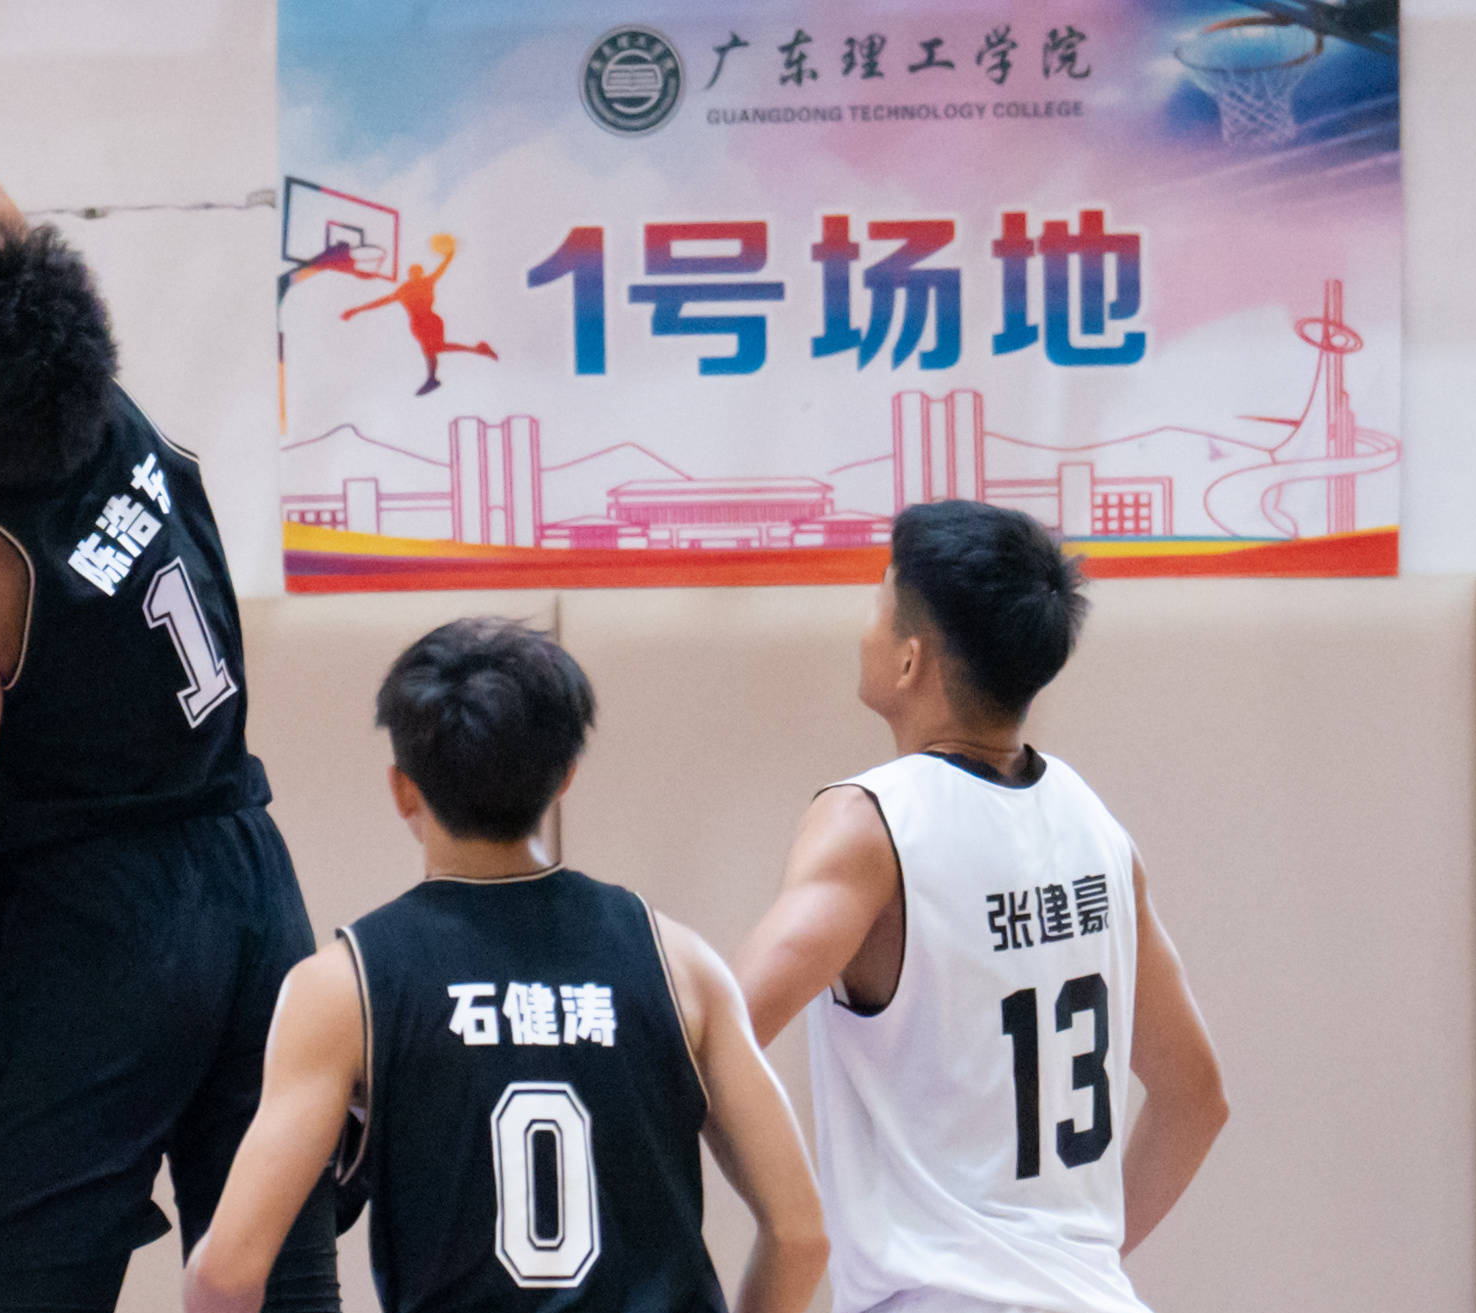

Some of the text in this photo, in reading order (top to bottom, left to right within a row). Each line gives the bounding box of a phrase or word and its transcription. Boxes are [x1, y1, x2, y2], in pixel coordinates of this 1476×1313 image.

[704, 24, 1093, 89] 广东理工学院
[706, 101, 1084, 125] GUANGDONG TECHNOLOGY COLLEGE
[527, 210, 1147, 376] 1号场地
[142, 556, 238, 729] 1
[447, 981, 617, 1047] 石健涛
[1001, 973, 1112, 1180] 13
[490, 1082, 601, 1289] 0
